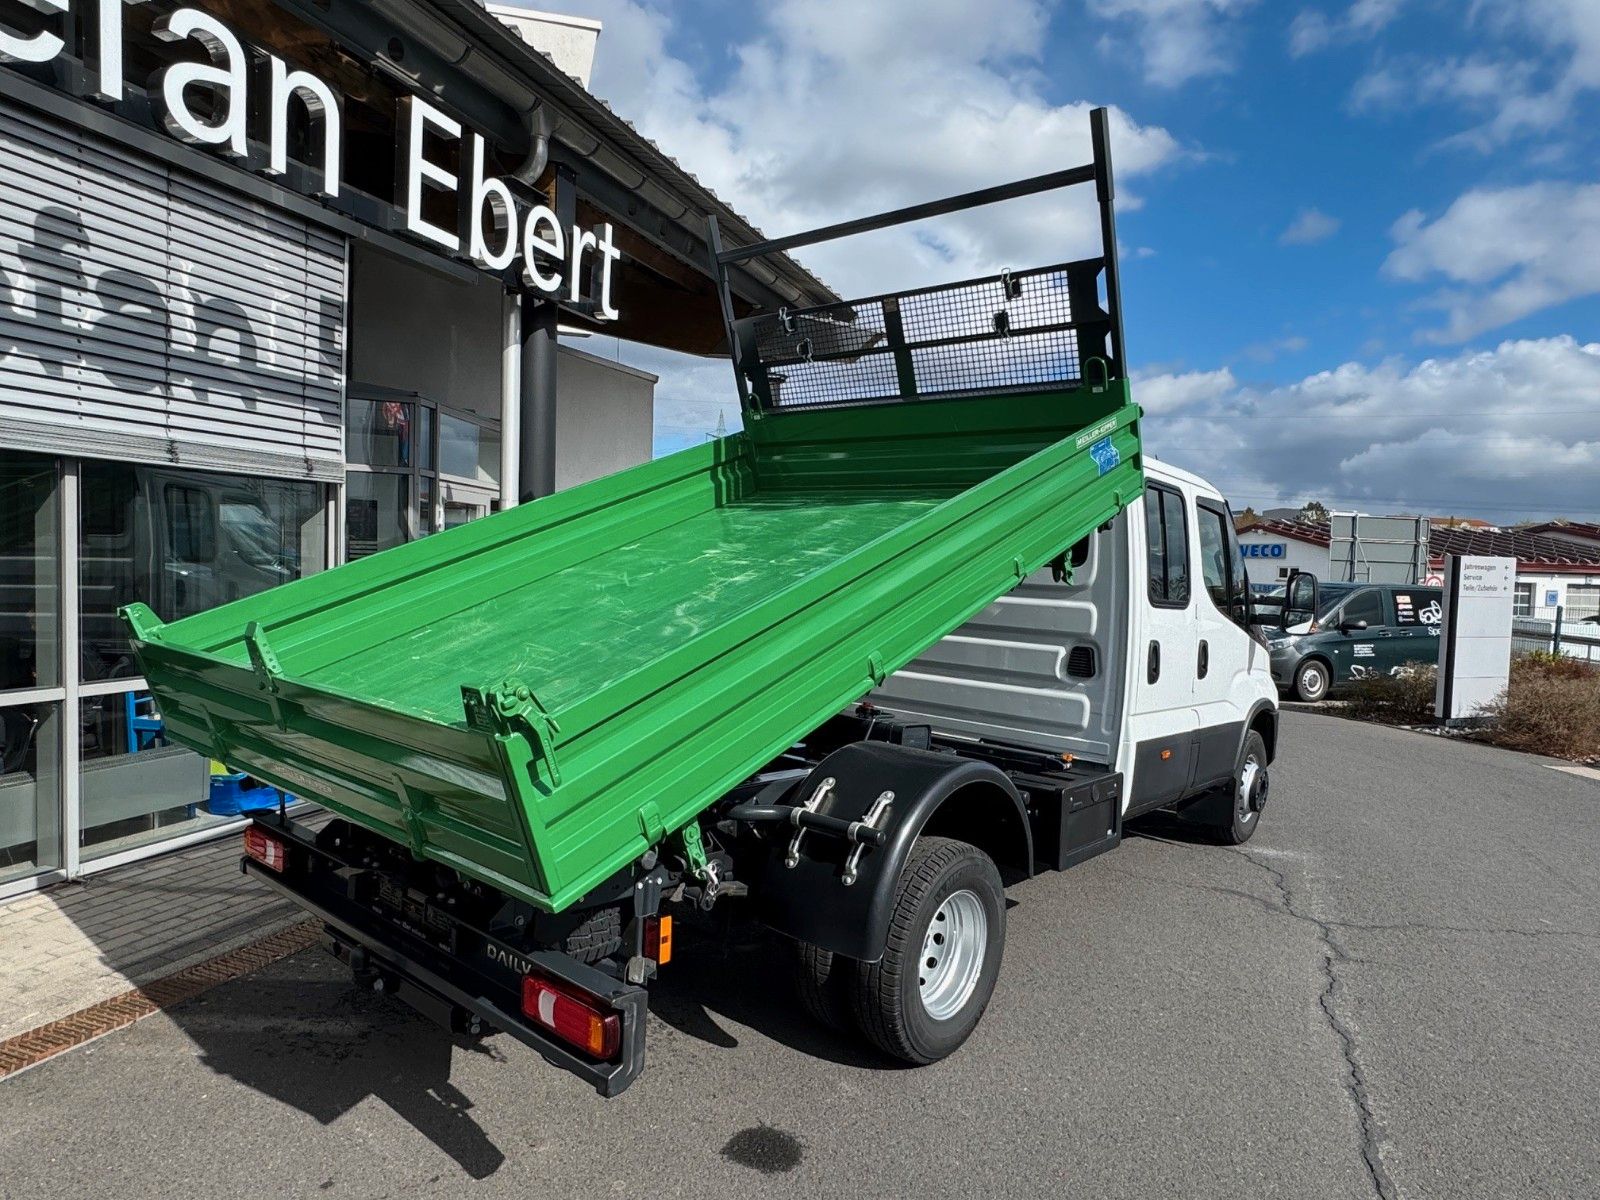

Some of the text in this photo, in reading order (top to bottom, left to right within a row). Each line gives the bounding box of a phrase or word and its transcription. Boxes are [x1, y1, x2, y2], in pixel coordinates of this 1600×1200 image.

[407, 96, 621, 320] Ebert
[1239, 544, 1282, 558] VECO
[487, 943, 532, 975] DAILY
